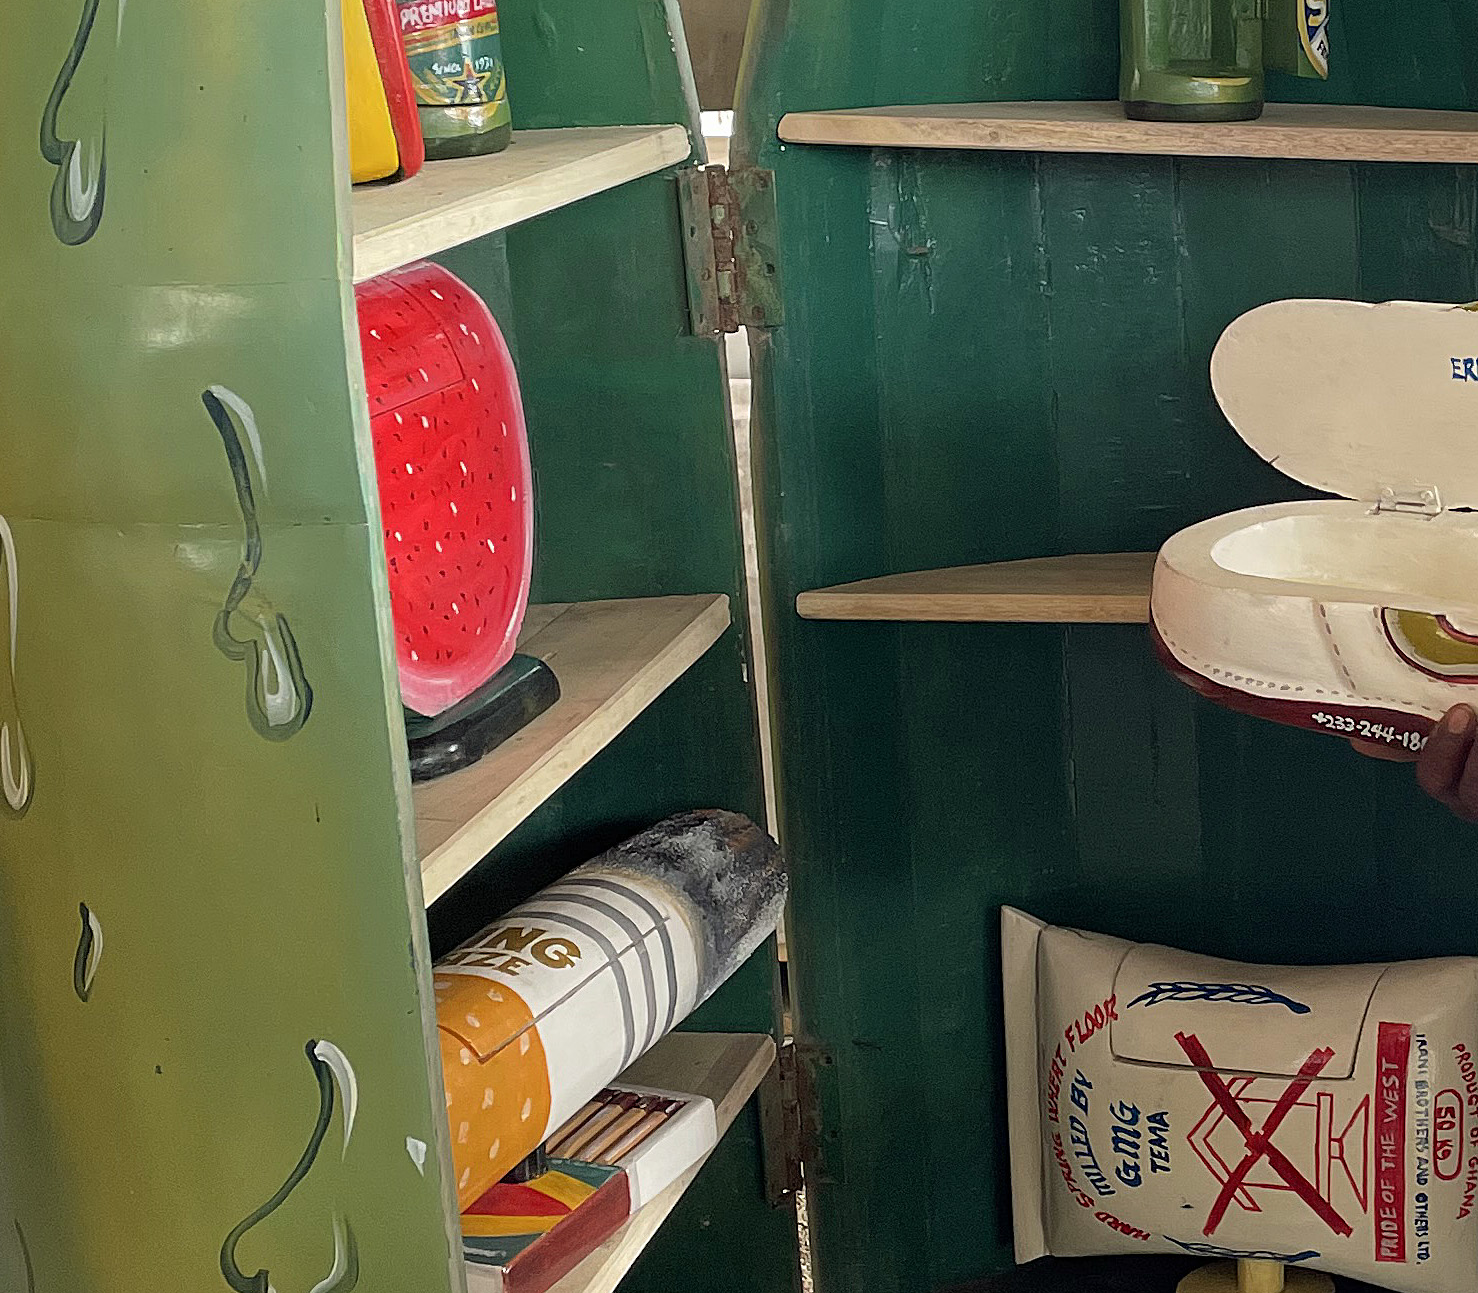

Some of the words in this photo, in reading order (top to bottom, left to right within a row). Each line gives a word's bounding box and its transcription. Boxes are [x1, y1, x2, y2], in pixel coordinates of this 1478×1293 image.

[456, 926, 583, 969] ING
[1048, 1041, 1067, 1124] WHEAT
[1070, 1068, 1094, 1116] BY
[1381, 1057, 1400, 1124] WEST
[1146, 1110, 1172, 1174] TEMA
[1414, 1080, 1430, 1154] BROTHERS
[1435, 1105, 1457, 1131] 50
[1068, 1114, 1117, 1196] MILLED
[1109, 1099, 1143, 1188] GMG
[1380, 1131, 1396, 1172] THE
[1051, 1131, 1096, 1209] SPRING
[1381, 1178, 1396, 1205] OF
[1415, 1156, 1429, 1187] AND
[1094, 1210, 1151, 1241] HARD
[1380, 1206, 1399, 1258] PRIDE
